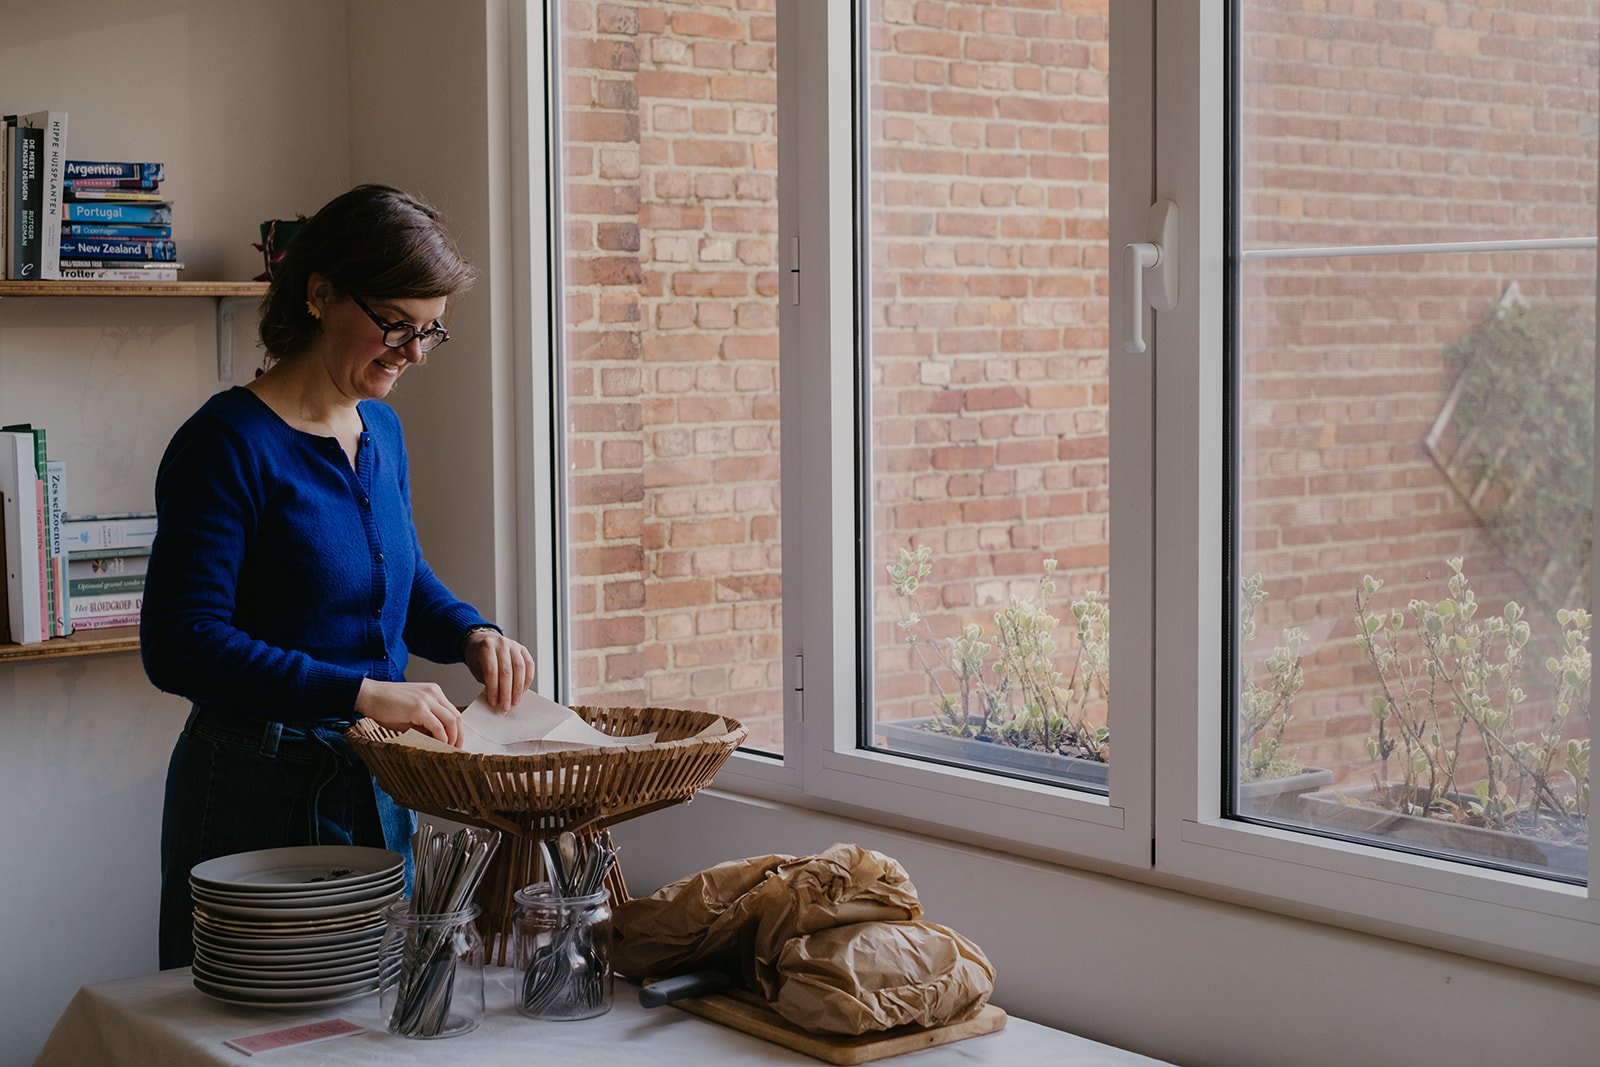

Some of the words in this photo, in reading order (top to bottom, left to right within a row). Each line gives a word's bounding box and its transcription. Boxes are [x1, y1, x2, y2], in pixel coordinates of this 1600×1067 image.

[52, 121, 60, 148] HIPPE
[29, 139, 35, 150] DE
[67, 163, 123, 177] Argentina
[50, 151, 58, 215] HUISPLANTEN
[76, 206, 123, 220] Portugal
[83, 227, 118, 236] Copenhagen
[78, 243, 101, 253] New
[102, 243, 142, 255] Zealand
[60, 269, 95, 278] Trotter
[52, 474, 60, 495] Zes
[53, 497, 61, 555] seizoenen
